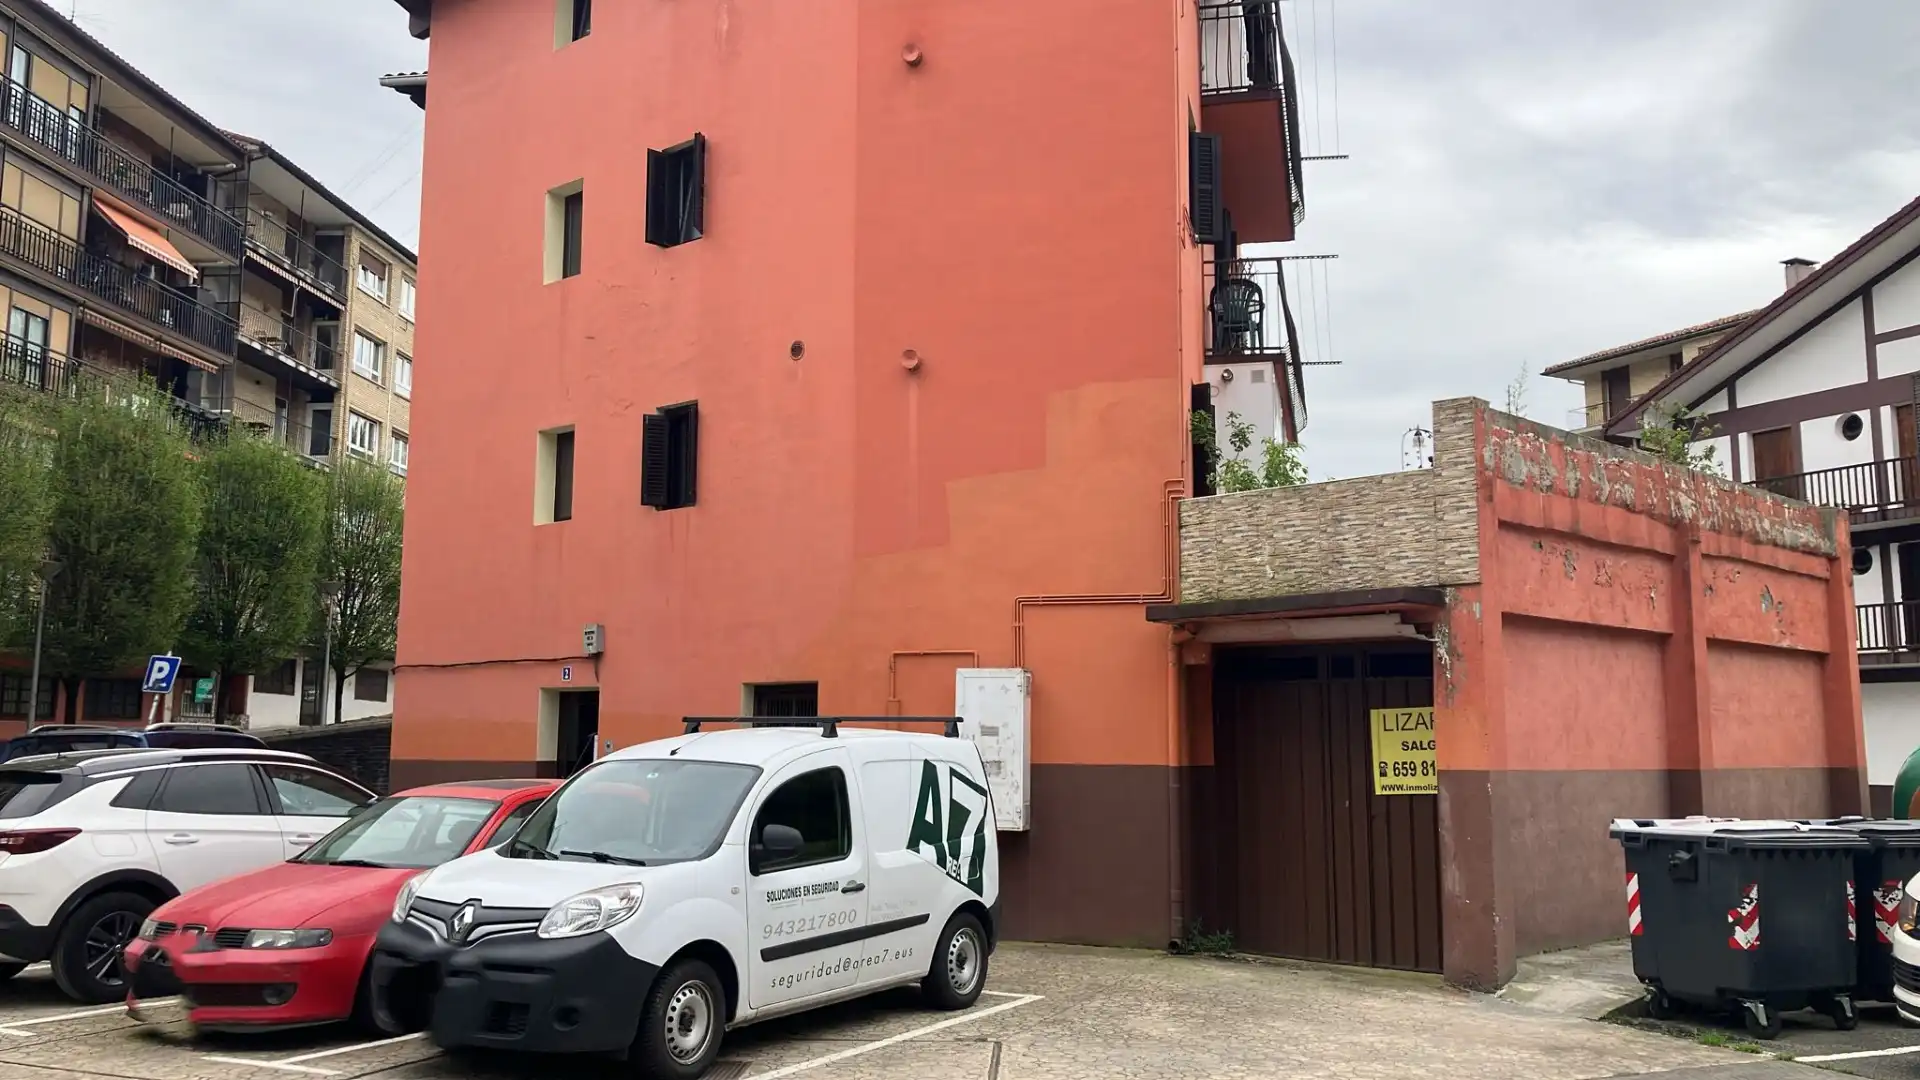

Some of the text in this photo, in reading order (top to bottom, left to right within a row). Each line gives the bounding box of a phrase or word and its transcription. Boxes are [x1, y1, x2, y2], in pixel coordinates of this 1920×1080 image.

[148, 660, 170, 687] P
[1401, 740, 1436, 751] SALG
[1393, 760, 1436, 777] 659 81
[766, 881, 839, 903] SOLUCIONES EN SEGURIDAD
[762, 909, 857, 940] 943217800
[770, 947, 913, 989] seguridad@area7.eus
